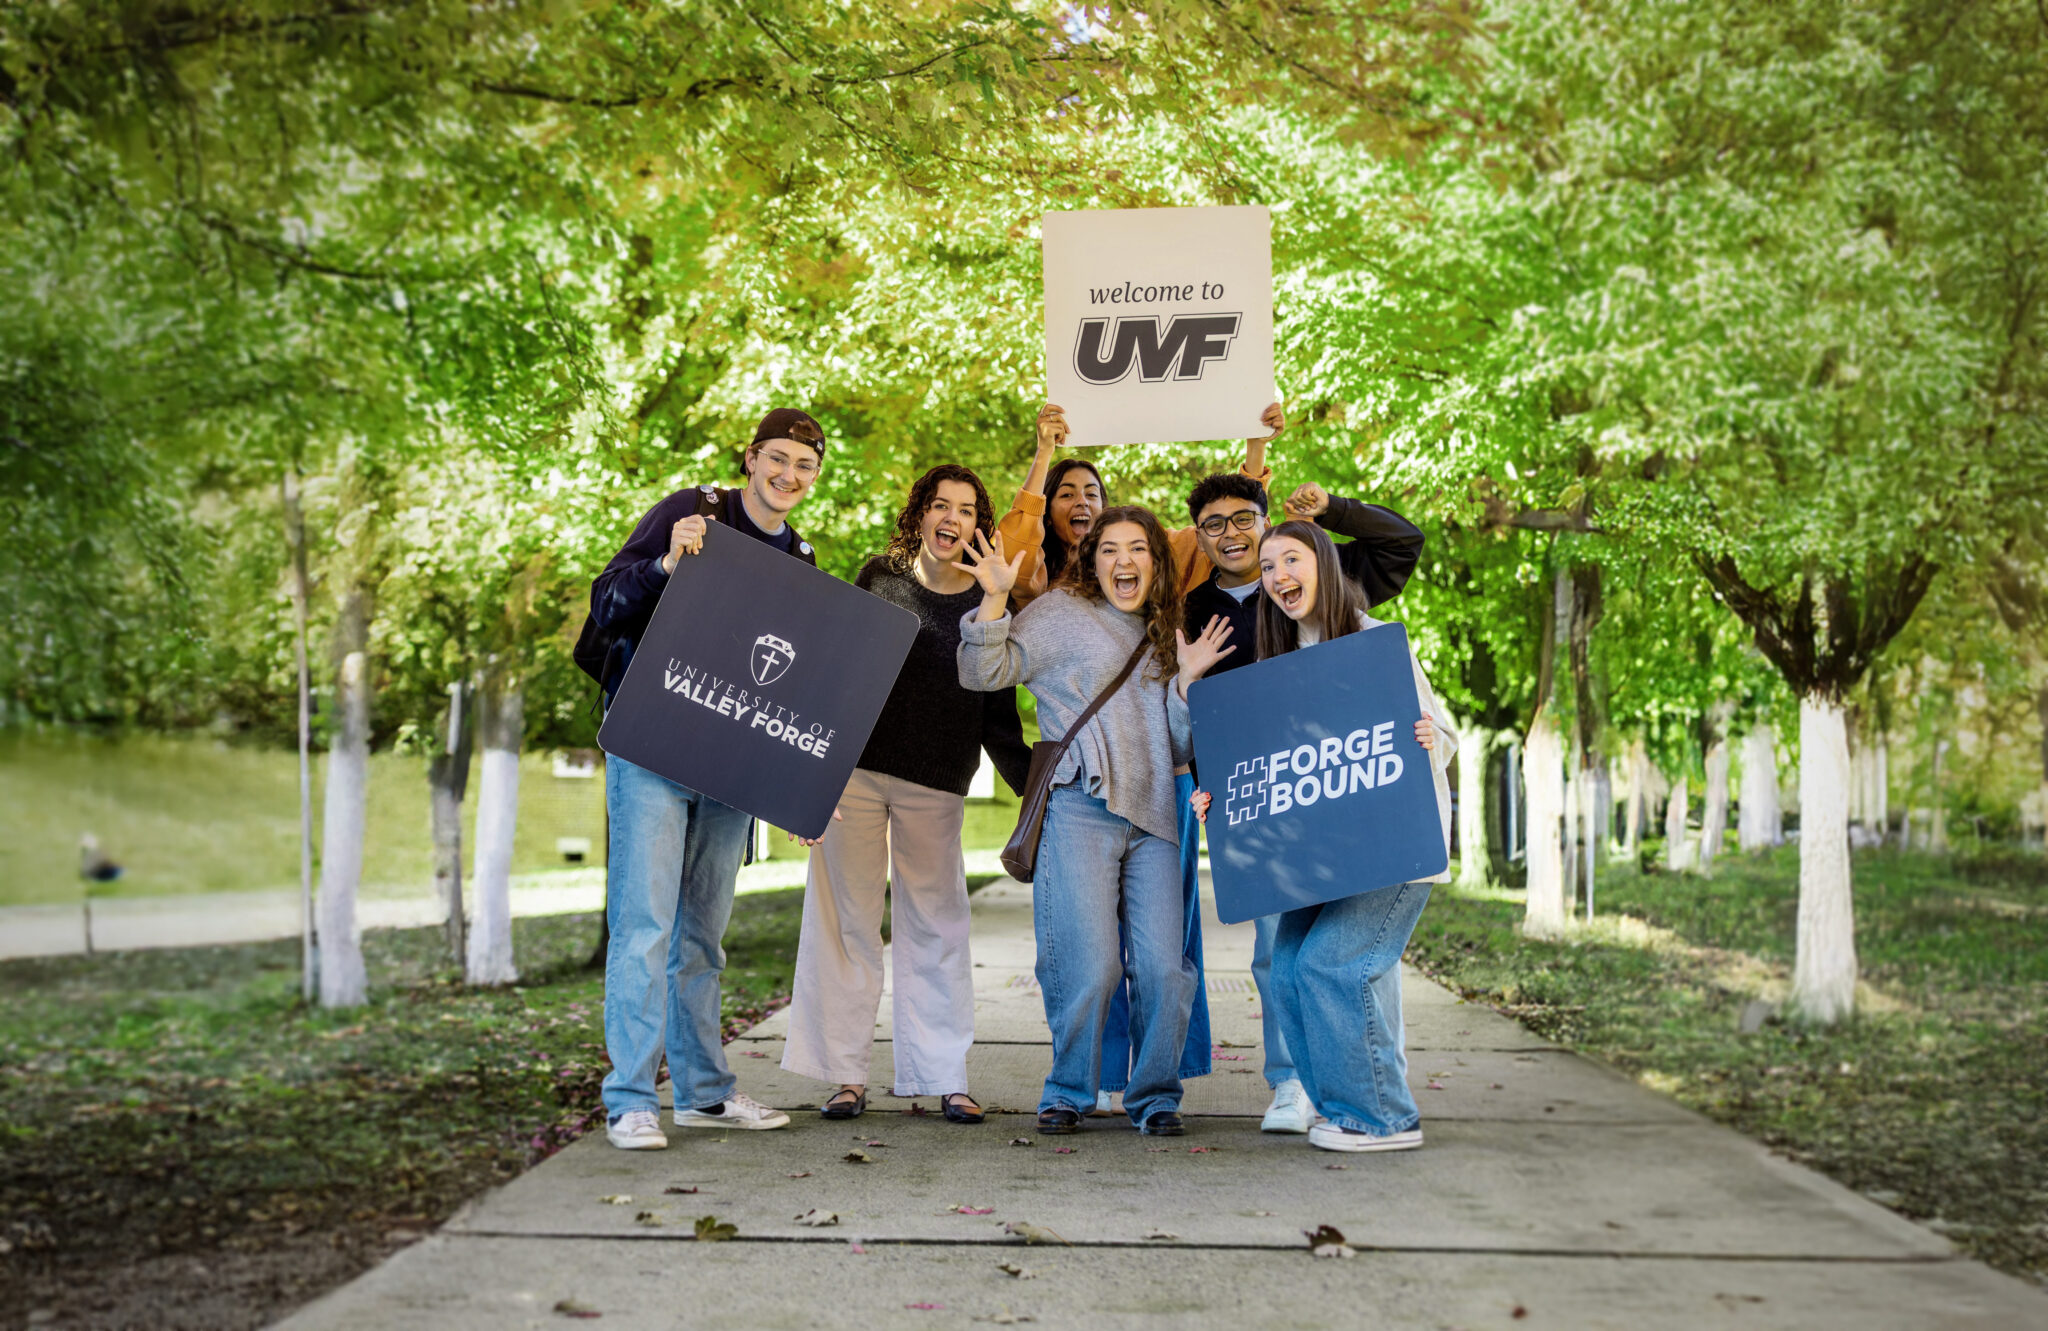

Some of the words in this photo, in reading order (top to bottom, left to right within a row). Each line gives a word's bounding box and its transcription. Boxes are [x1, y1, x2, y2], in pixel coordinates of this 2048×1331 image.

[1090, 281, 1193, 304] welcome
[1201, 281, 1224, 300] to
[1073, 312, 1243, 385] UVF
[664, 669, 751, 721] VALLEY
[750, 711, 831, 759] FORGE
[668, 658, 800, 724] UNIVERSITY
[811, 722, 836, 740] OF
[1269, 754, 1404, 815] BOUND
